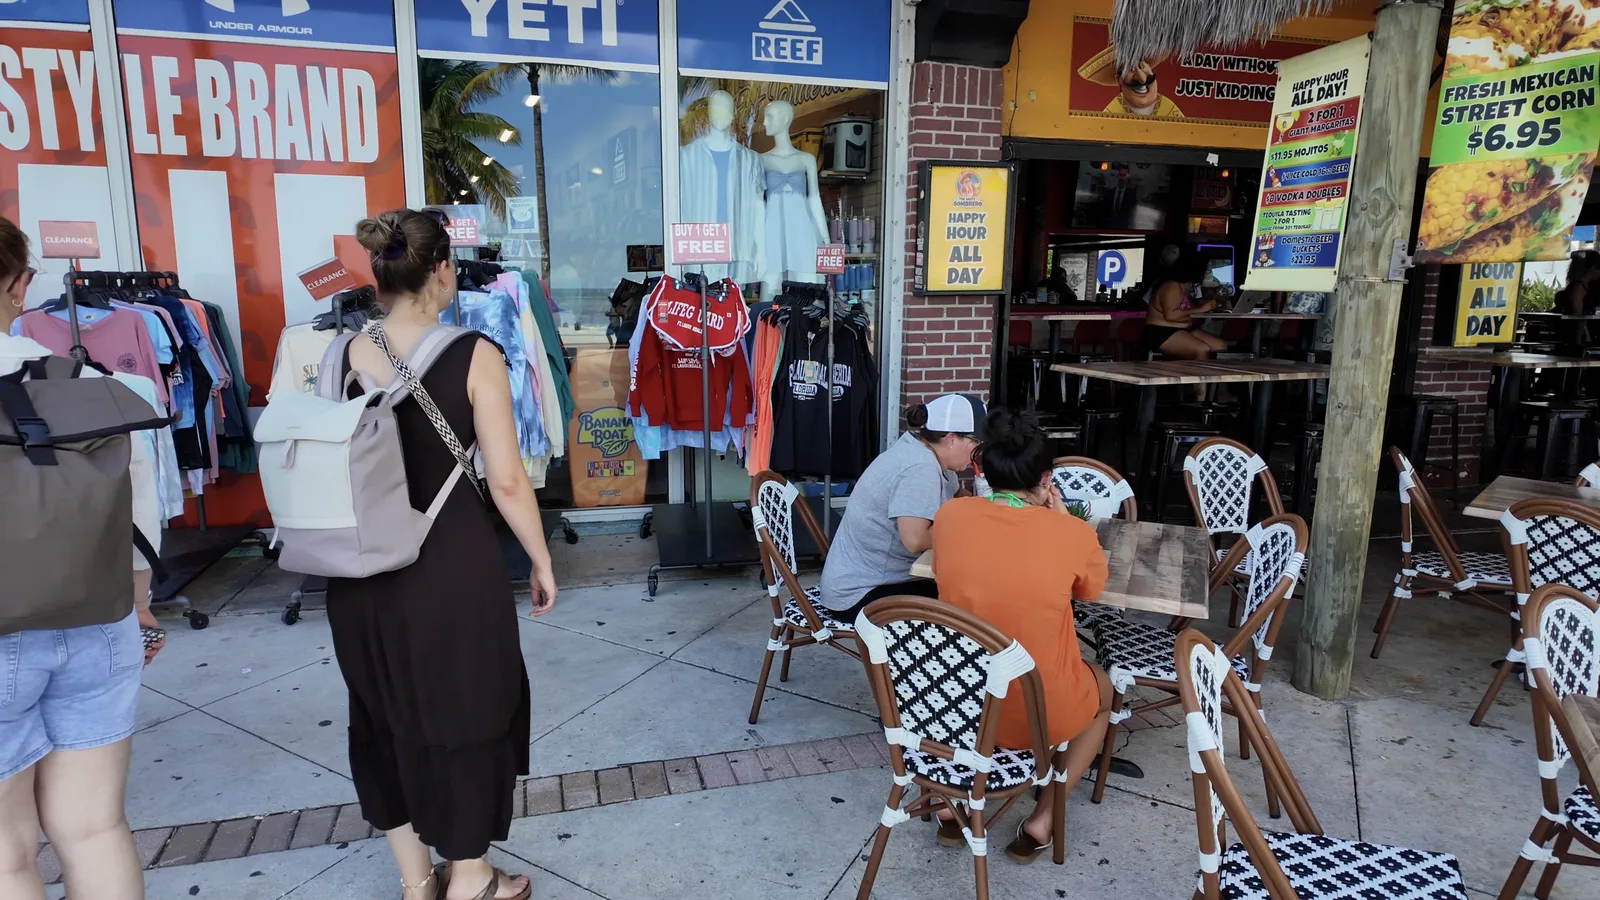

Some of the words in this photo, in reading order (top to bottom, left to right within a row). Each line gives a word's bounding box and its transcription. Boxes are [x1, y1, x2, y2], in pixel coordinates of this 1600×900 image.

[209, 20, 254, 32] UNDER
[257, 24, 313, 35] ARMOUR
[466, 0, 618, 47] YETI
[755, 35, 820, 63] REEF
[1196, 53, 1220, 69] DAY
[1176, 80, 1214, 97] JUST
[1292, 76, 1322, 92] HAPPY
[1324, 69, 1349, 84] HOUR
[1443, 79, 1506, 104] FRESH
[1510, 64, 1595, 95] MEXICAN
[1291, 89, 1313, 107] ALL
[1317, 79, 1348, 101] DAY!
[194, 58, 380, 164] BRAND
[1308, 112, 1314, 123] 2
[1317, 108, 1336, 121] FOR
[1339, 105, 1344, 117] 1
[1440, 98, 1527, 126] STREET
[1531, 87, 1596, 115] CORN
[1289, 127, 1309, 137] GIANT
[1310, 117, 1354, 134] MARGARITAS
[1467, 117, 1562, 156] $6.95
[1271, 150, 1292, 161] $11.95
[1294, 144, 1328, 157] MOJITOS
[1290, 171, 1300, 179] ICE
[1302, 168, 1317, 178] COLD
[1332, 163, 1349, 173] BEER
[1276, 190, 1305, 202] VODKA
[1306, 186, 1341, 199] DOUBLES
[948, 213, 986, 223] HAPPY
[1286, 209, 1311, 217] TASTING
[446, 227, 476, 239] REE
[675, 224, 692, 236] BUY
[696, 224, 700, 236] 1
[703, 224, 720, 236] GET
[723, 224, 727, 236] 1
[946, 226, 987, 240] HOUR
[45, 236, 94, 245] CLEARANCE
[678, 240, 726, 253] FREE
[1282, 236, 1314, 245] DOMESTIC
[1315, 234, 1333, 243] BEER
[949, 245, 982, 263] ALL
[1292, 245, 1321, 253] BUCKETS
[817, 256, 843, 266] FREE
[1291, 255, 1316, 265] $22.95
[947, 268, 983, 284] DAY
[1104, 257, 1121, 281] P
[1470, 263, 1514, 280] HOUR
[306, 266, 348, 291] CLEARANCE
[1470, 287, 1507, 309] ALL
[1466, 315, 1507, 337] DAY
[580, 414, 633, 431] BANANA
[591, 429, 626, 445] BOAT
